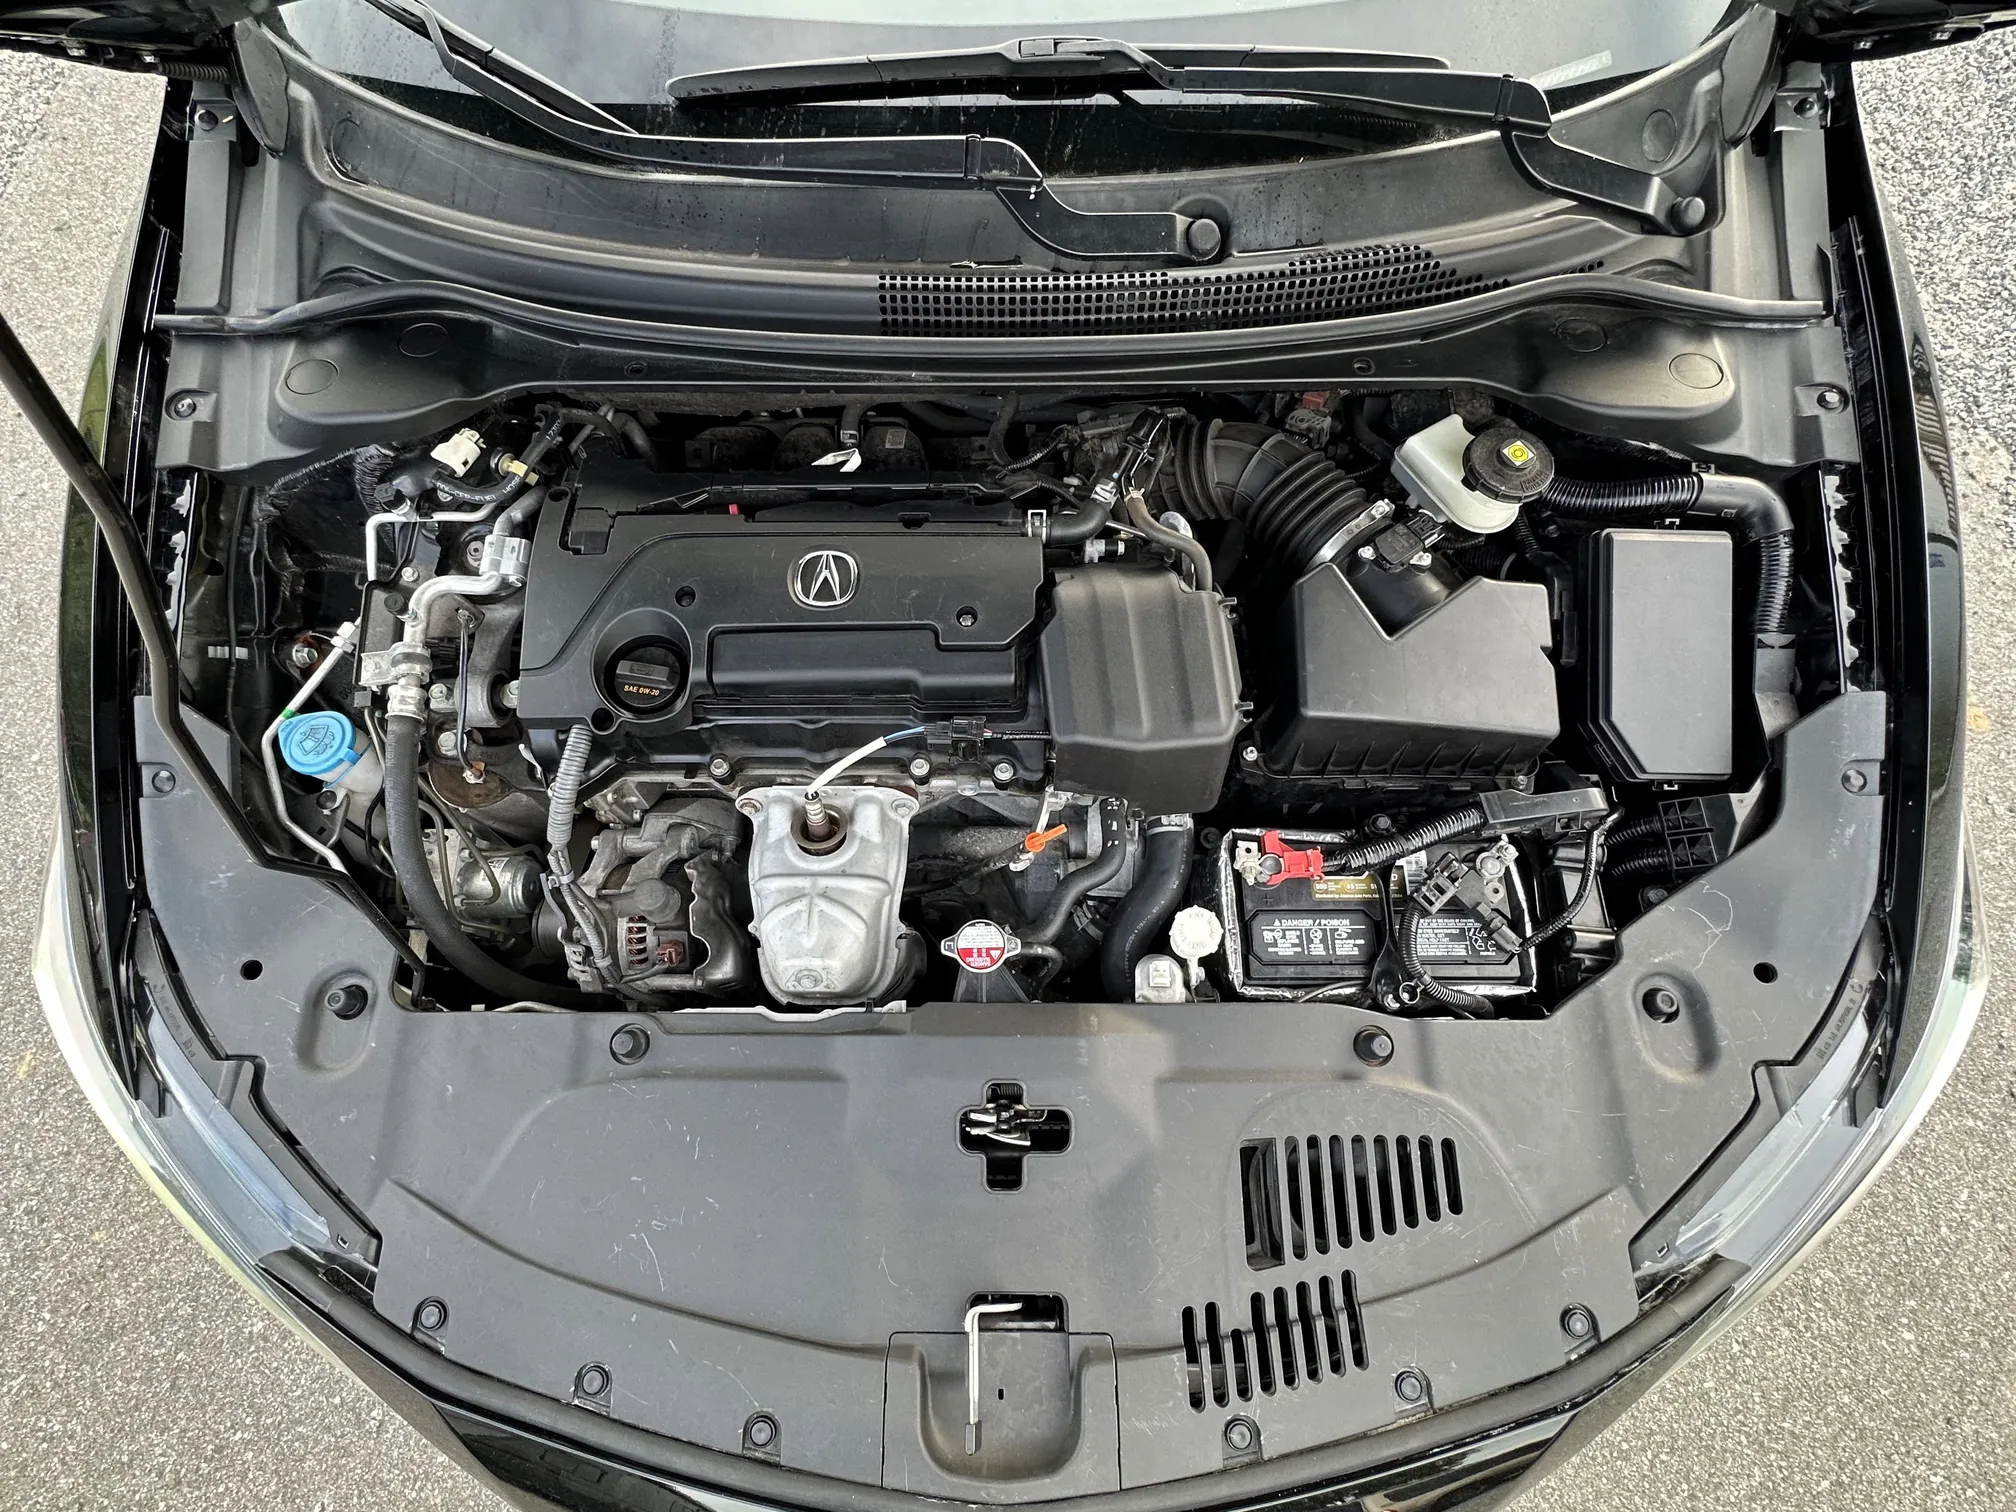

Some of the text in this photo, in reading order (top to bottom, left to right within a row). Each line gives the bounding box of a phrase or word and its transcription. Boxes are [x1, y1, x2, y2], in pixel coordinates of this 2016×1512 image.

[623, 685, 660, 696] SAE 0W-20
[1281, 918, 1314, 927] DANGER
[1320, 918, 1350, 926] POISON
